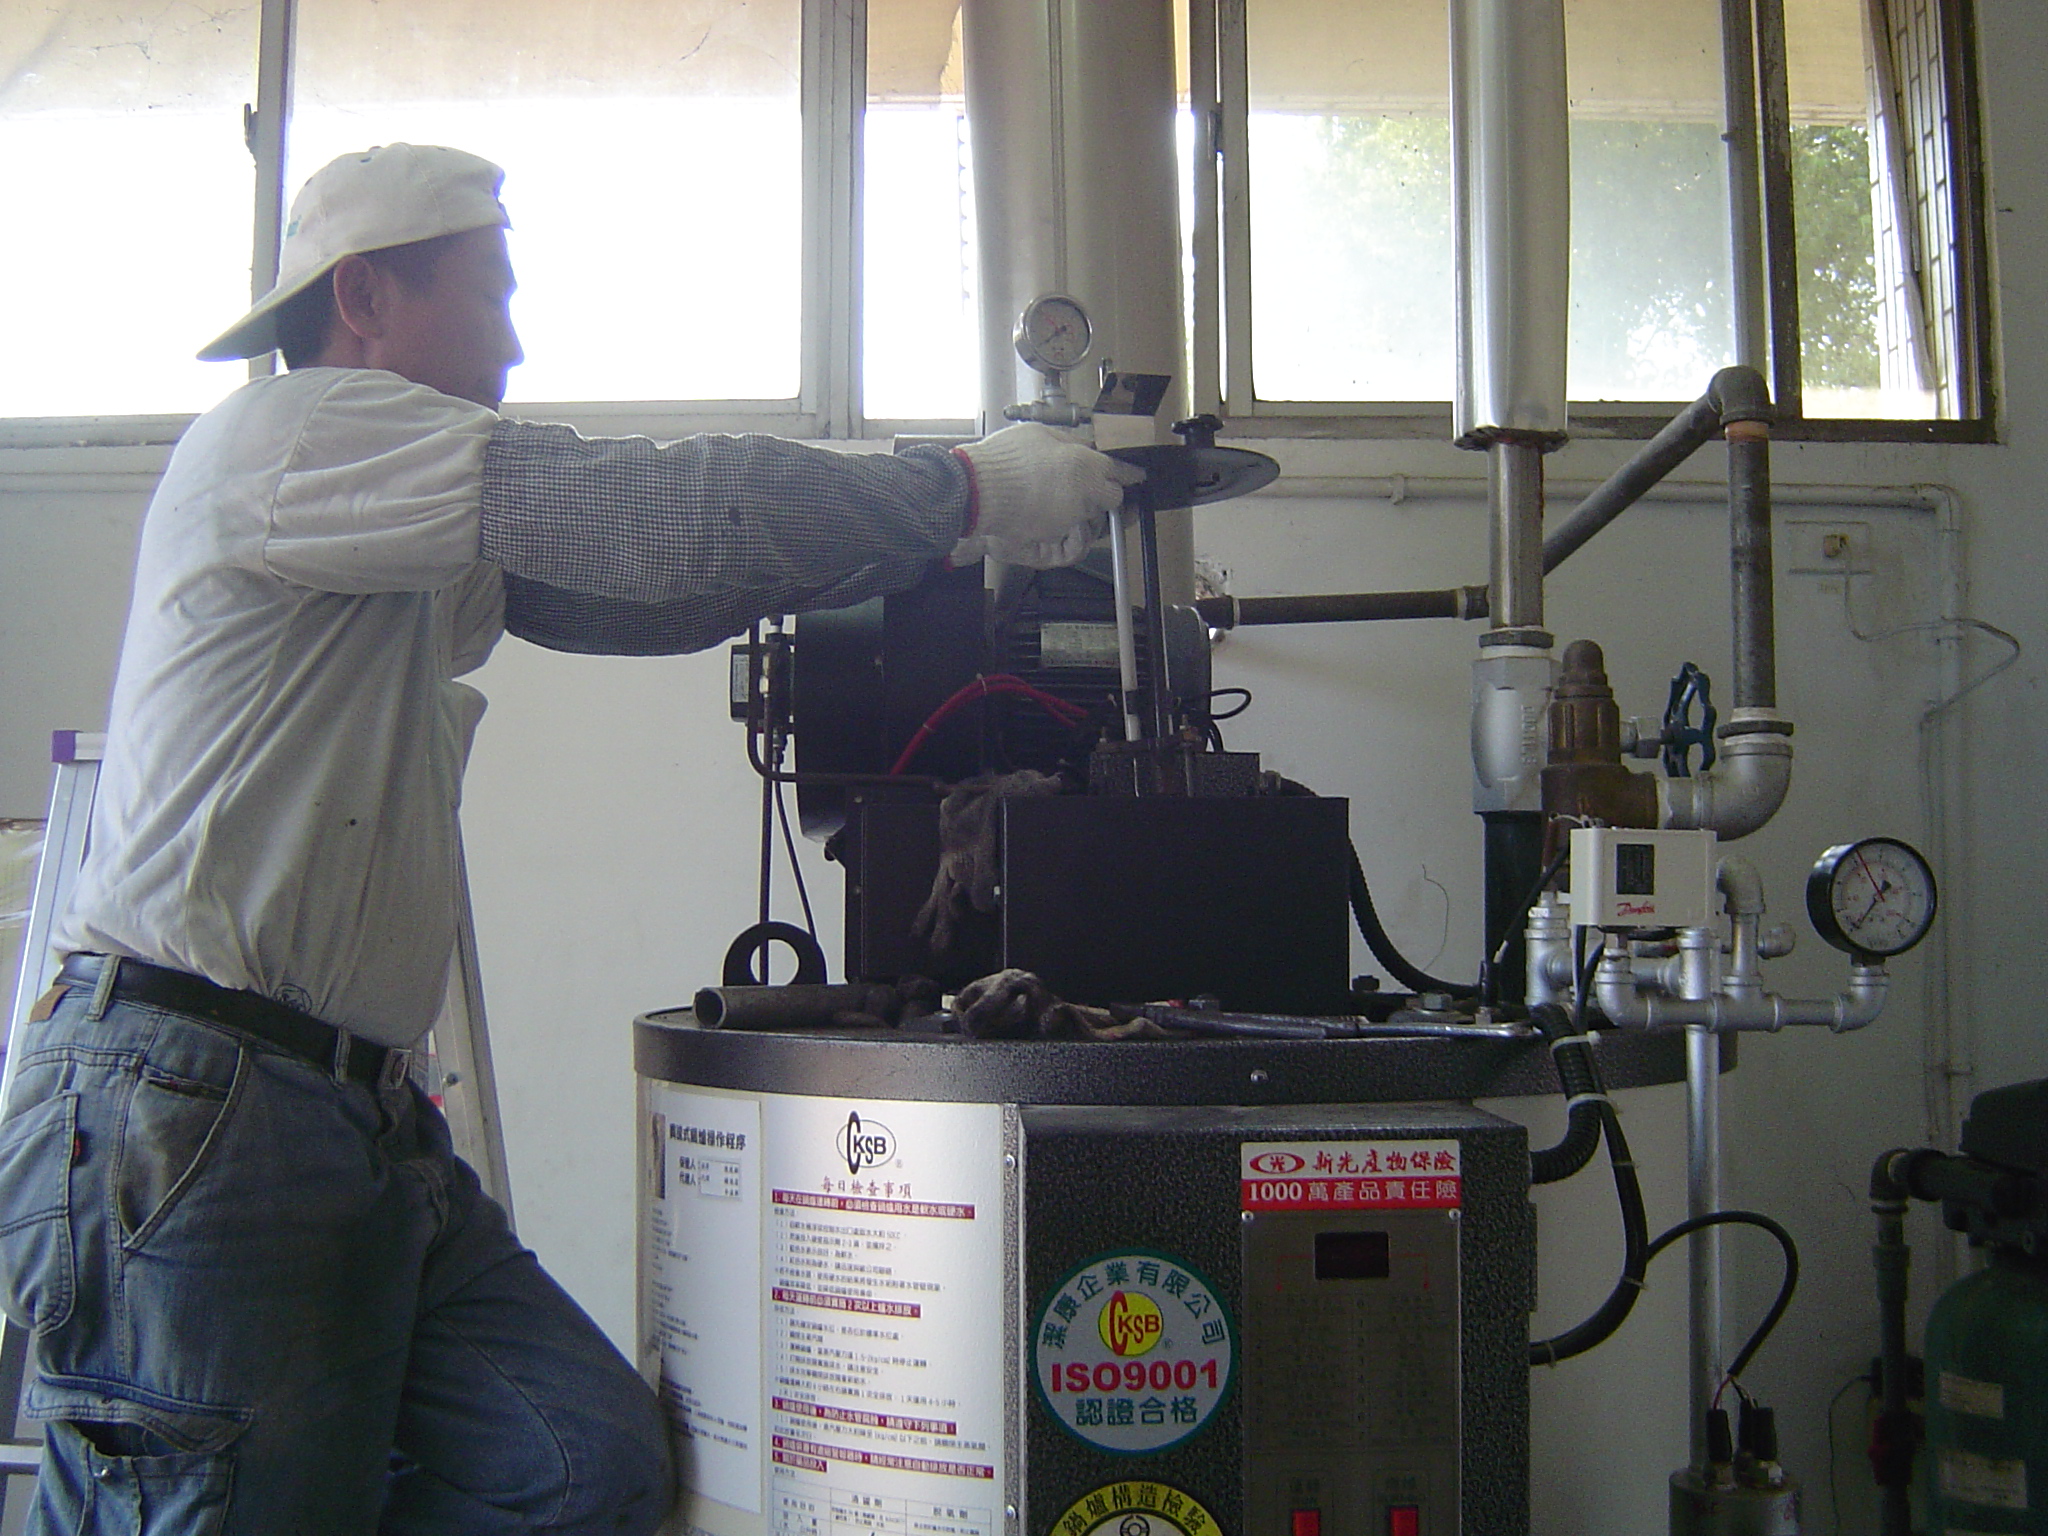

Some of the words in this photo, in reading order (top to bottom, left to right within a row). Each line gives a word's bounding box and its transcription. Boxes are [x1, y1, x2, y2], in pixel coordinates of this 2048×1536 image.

[1312, 1149, 1456, 1174] 新光產物保險
[821, 1175, 912, 1199] 每日檢查事項
[1249, 1182, 1303, 1201] 1000
[1308, 1180, 1457, 1202] 萬產品責任險
[1052, 1359, 1217, 1392] ISO9001
[1076, 1396, 1198, 1425] 認證合格
